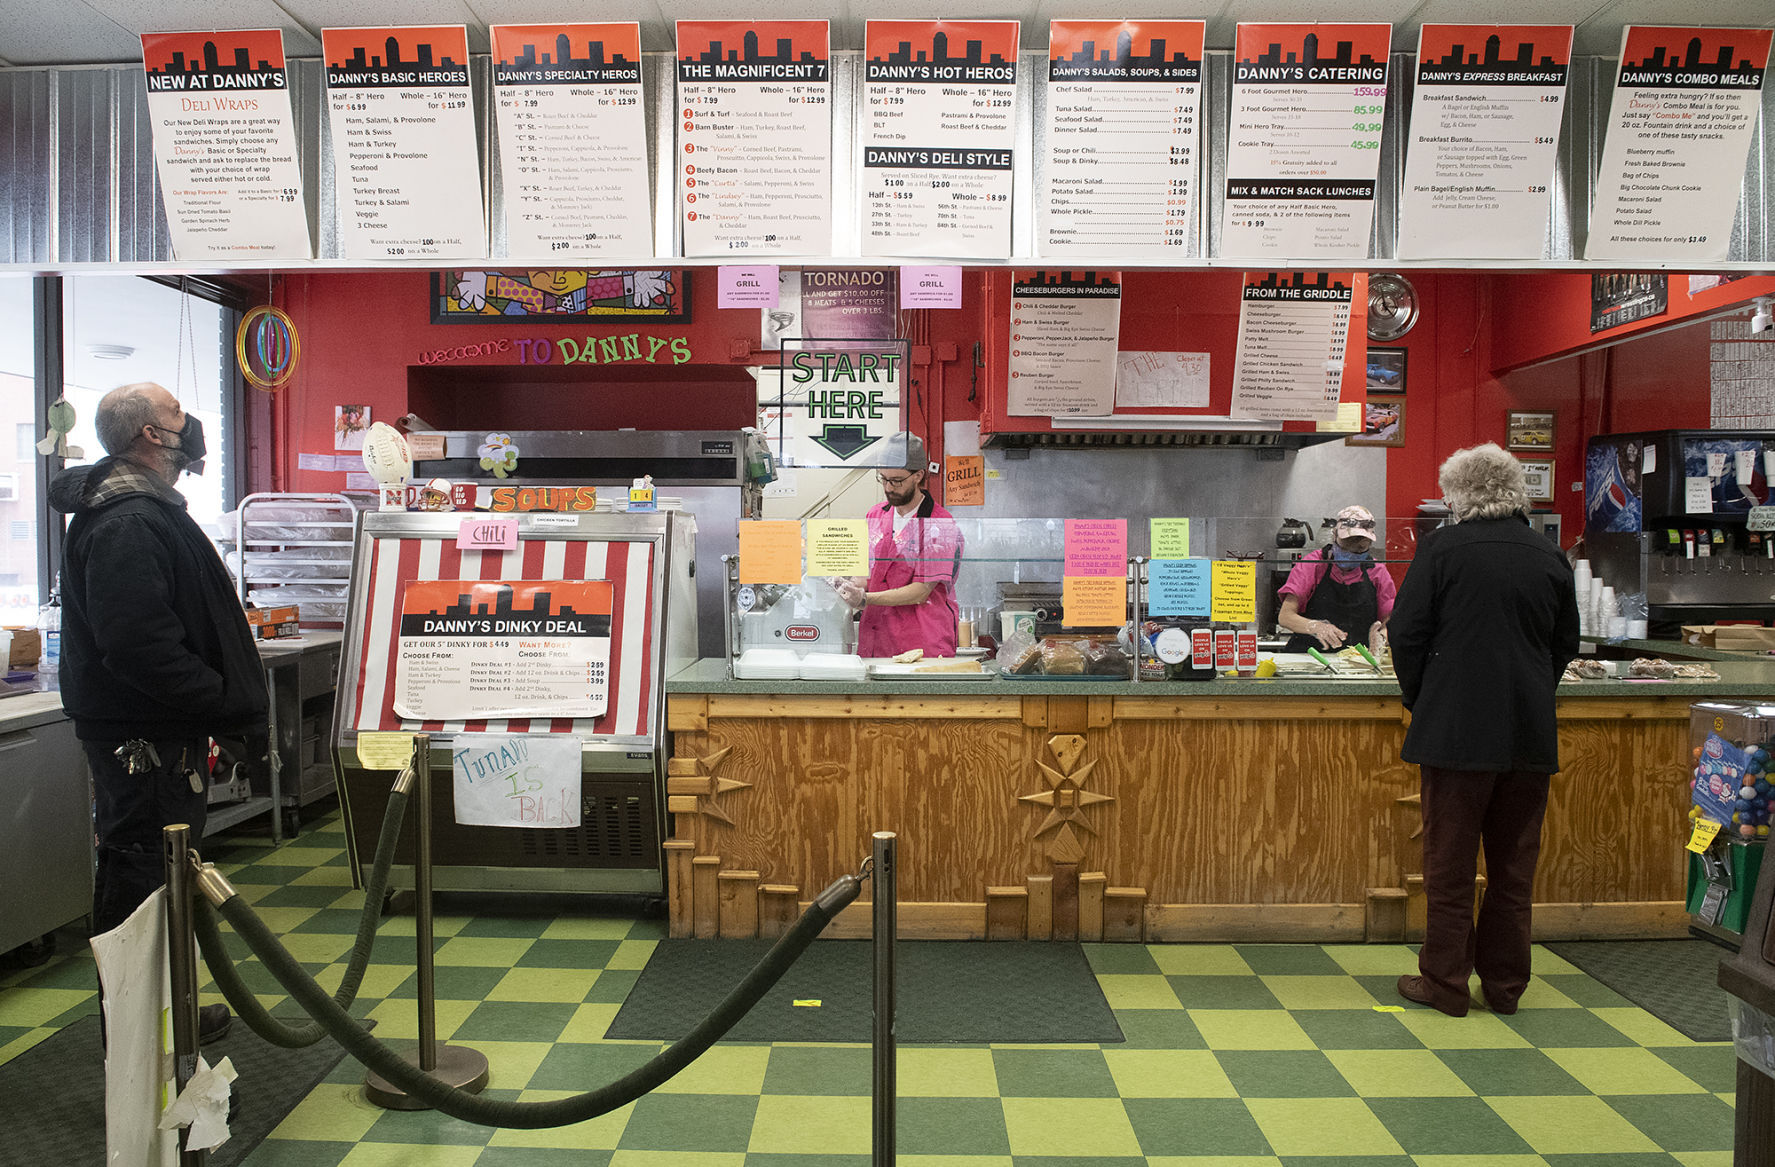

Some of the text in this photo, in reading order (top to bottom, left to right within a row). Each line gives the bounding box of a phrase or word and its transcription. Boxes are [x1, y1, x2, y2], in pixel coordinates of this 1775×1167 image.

[498, 69, 638, 81] DANNY'S SPECIALTY HEROS
[682, 64, 825, 78] THE MAGNIFICENT 7
[870, 66, 1013, 80] DANNY'S HOT HEROS
[1053, 68, 1197, 78] DANNY'S SALADS, SOUPS, & SIDES
[1238, 67, 1383, 80] DANNY'S CATERING
[1421, 72, 1563, 82] DANNY'S EXPRESS BREAKFAST
[150, 73, 284, 90] NEW AT DANNY'S
[330, 72, 466, 84] DANNY'S BASIC HEROES
[1621, 72, 1760, 86] DANNY'S COMBO MEALS
[1353, 87, 1388, 97] 159.99
[181, 97, 259, 112] DELI WRAPS
[1353, 105, 1383, 115] 85.99
[207, 119, 229, 127] Wraps
[248, 118, 266, 126] great
[1271, 123, 1284, 131] Tray
[1351, 122, 1382, 133] 49.99
[349, 152, 384, 160] Pepperoni
[868, 151, 1010, 166] DANNY'S DELI STYLE
[696, 167, 715, 175] Beefy
[1231, 186, 1371, 196] MIX & MATCH SACK LUNCHES
[1051, 198, 1070, 206] Chips
[736, 280, 761, 288] GRILL
[804, 271, 884, 287] TORNADO
[844, 290, 868, 298] $10.00
[1085, 287, 1119, 295] PARADISE
[1245, 288, 1352, 299] FROM THE GRIDDLE
[513, 338, 551, 365] TO
[556, 333, 692, 365] DANNY'S
[792, 352, 901, 383] START
[808, 390, 884, 419] HERE
[947, 466, 981, 482] GRILL
[493, 486, 596, 512] SOUPS
[424, 620, 587, 633] DANNY'S DINKY DEAL
[790, 629, 815, 639] Berkel
[1161, 648, 1184, 657] Google
[504, 764, 544, 798] IS
